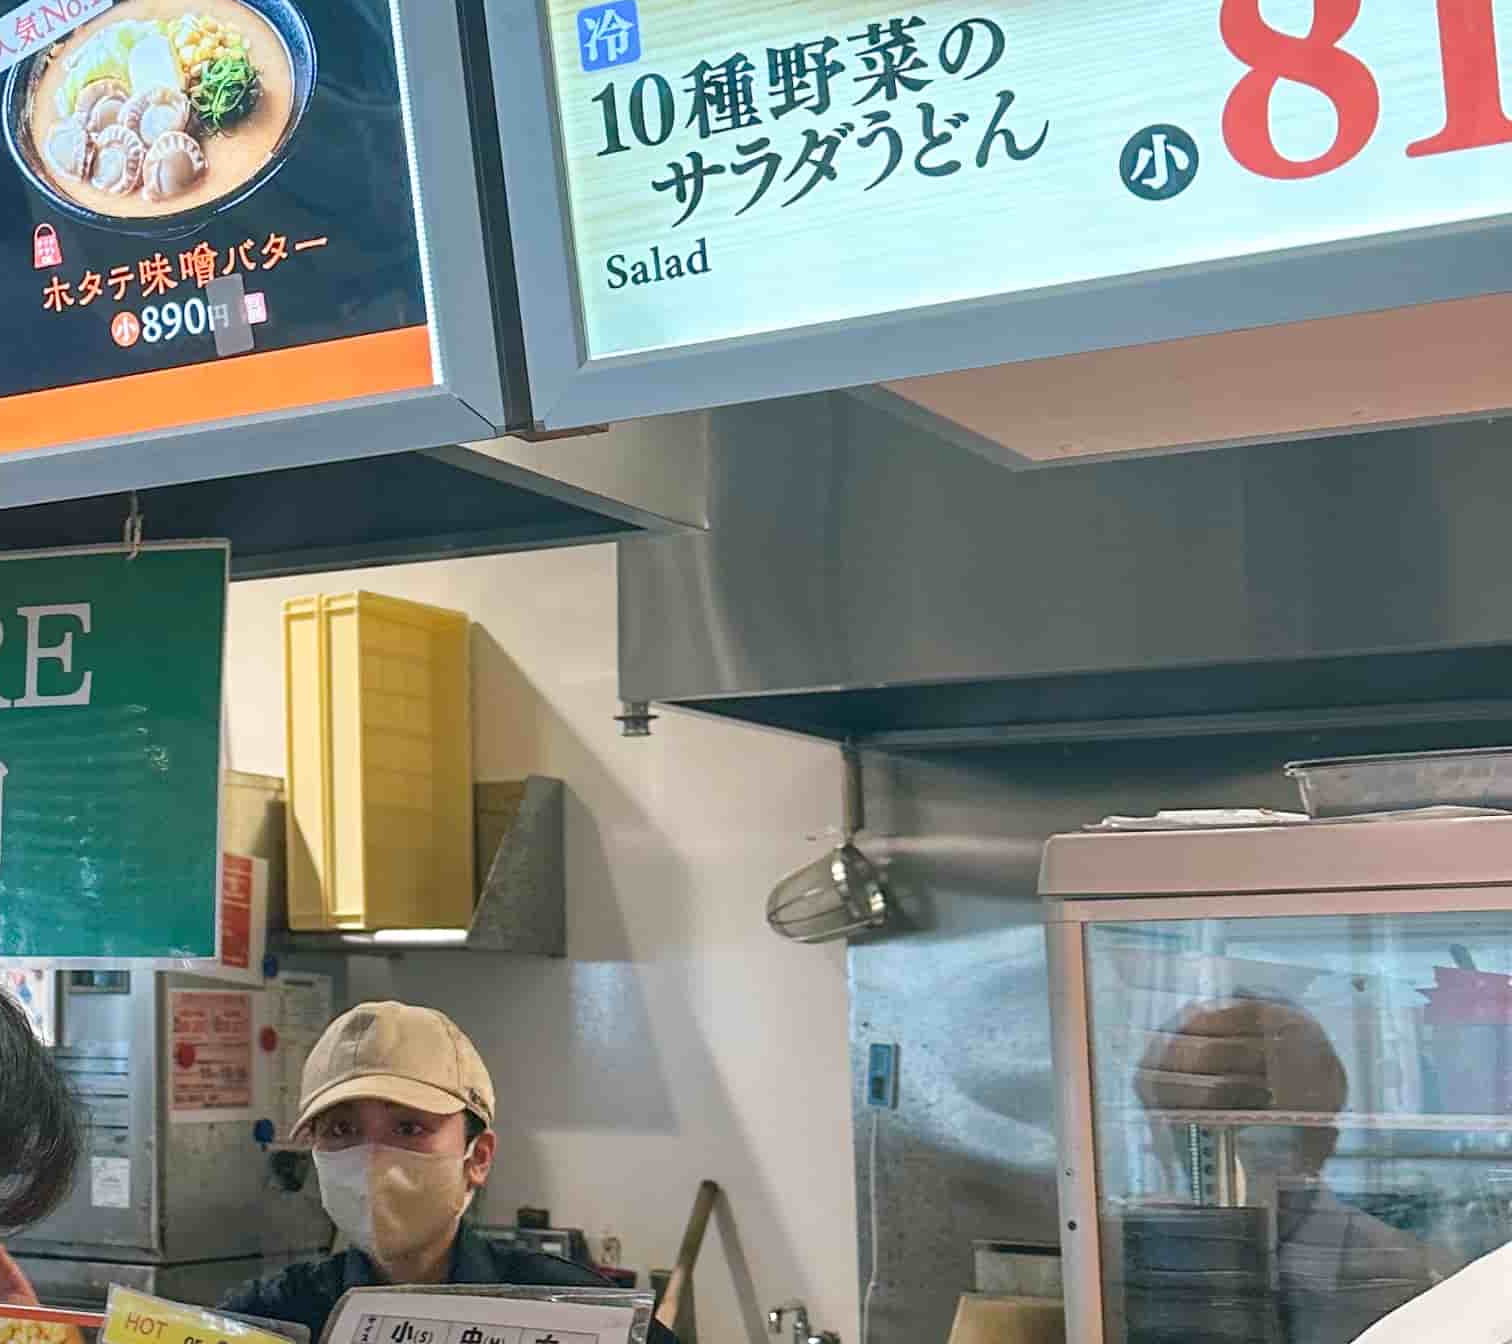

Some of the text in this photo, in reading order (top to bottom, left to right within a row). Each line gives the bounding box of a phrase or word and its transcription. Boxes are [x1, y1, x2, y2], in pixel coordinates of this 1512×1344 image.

[580, 7, 638, 66] 冷
[590, 16, 1008, 157] 10種野菜の
[650, 89, 1050, 229] サラダうどん
[605, 237, 711, 291] Salad
[125, 1311, 168, 1339] HOT
